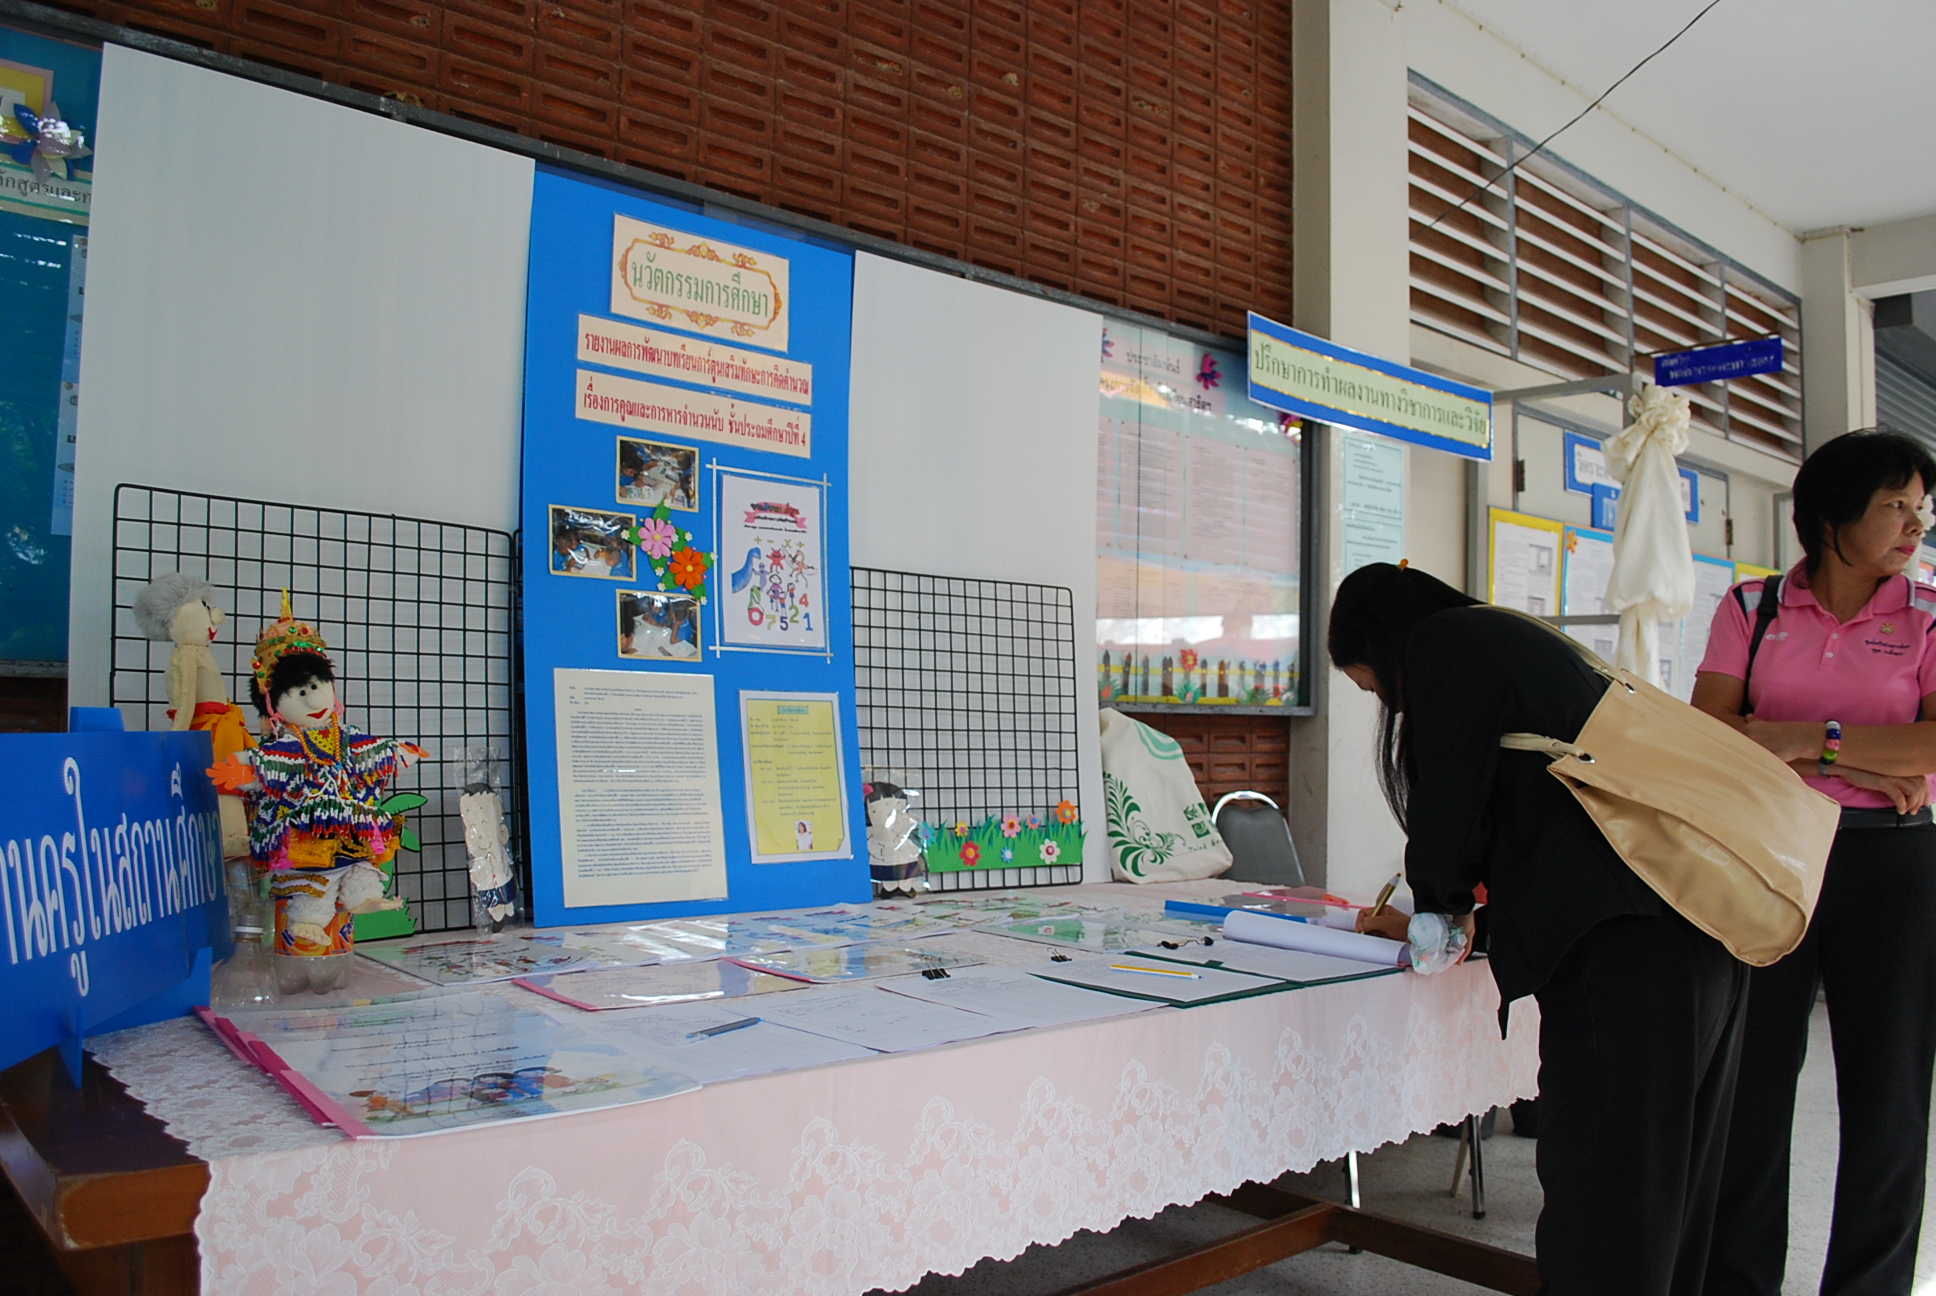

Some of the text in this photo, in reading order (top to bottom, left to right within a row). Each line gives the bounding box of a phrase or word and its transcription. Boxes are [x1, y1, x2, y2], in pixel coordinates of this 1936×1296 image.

[631, 251, 768, 318] นวัตกรรมการศึกษา
[1254, 342, 1487, 436] ปรึกษาการทำผลงานทางวิชาการและวิจัย
[584, 376, 724, 432] เรื่องการคูณและการหารจำนวนนับ
[729, 403, 800, 446] ชั้นประถมศึกษาปีที่
[766, 614, 777, 630] 7
[779, 615, 789, 631] 5
[803, 612, 813, 631] 1
[789, 604, 799, 624] 2
[799, 593, 809, 607] 4
